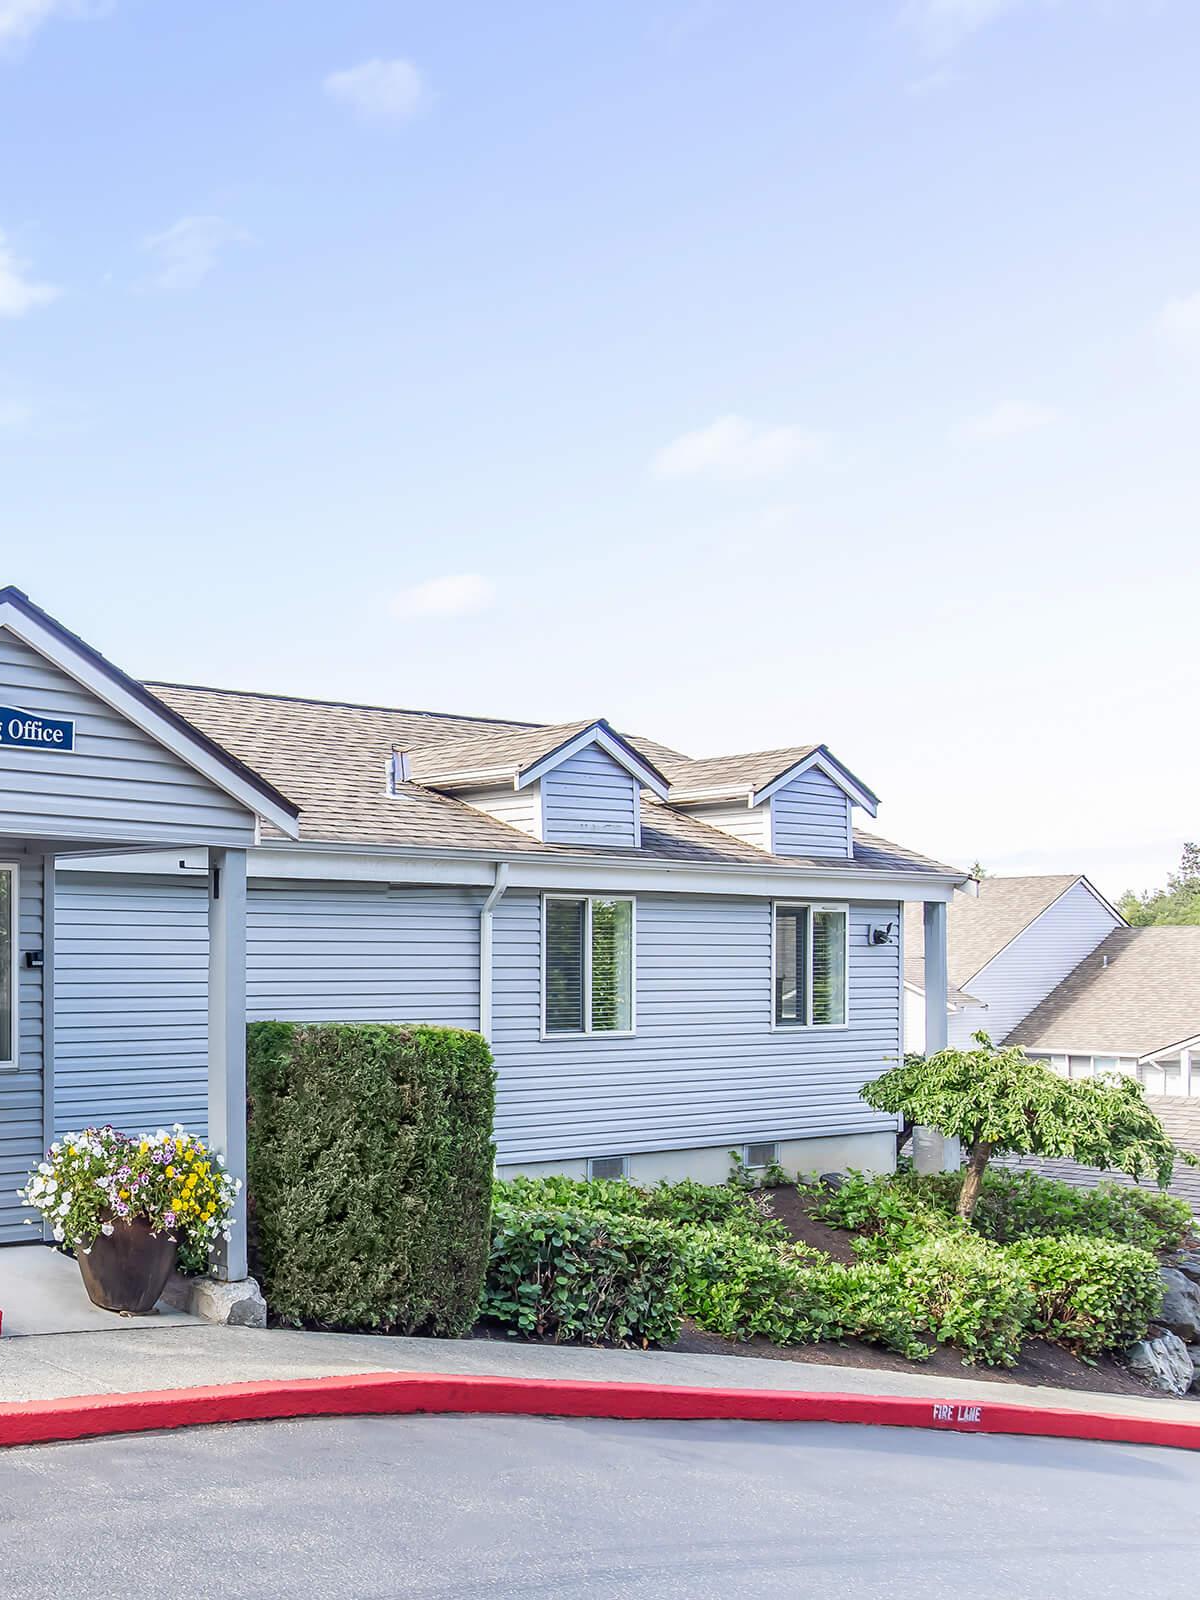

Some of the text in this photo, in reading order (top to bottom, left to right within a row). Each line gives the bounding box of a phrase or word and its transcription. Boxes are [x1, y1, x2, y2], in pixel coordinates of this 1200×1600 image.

[8, 718, 64, 743] Office
[933, 1404, 981, 1422] FIRE LANE
